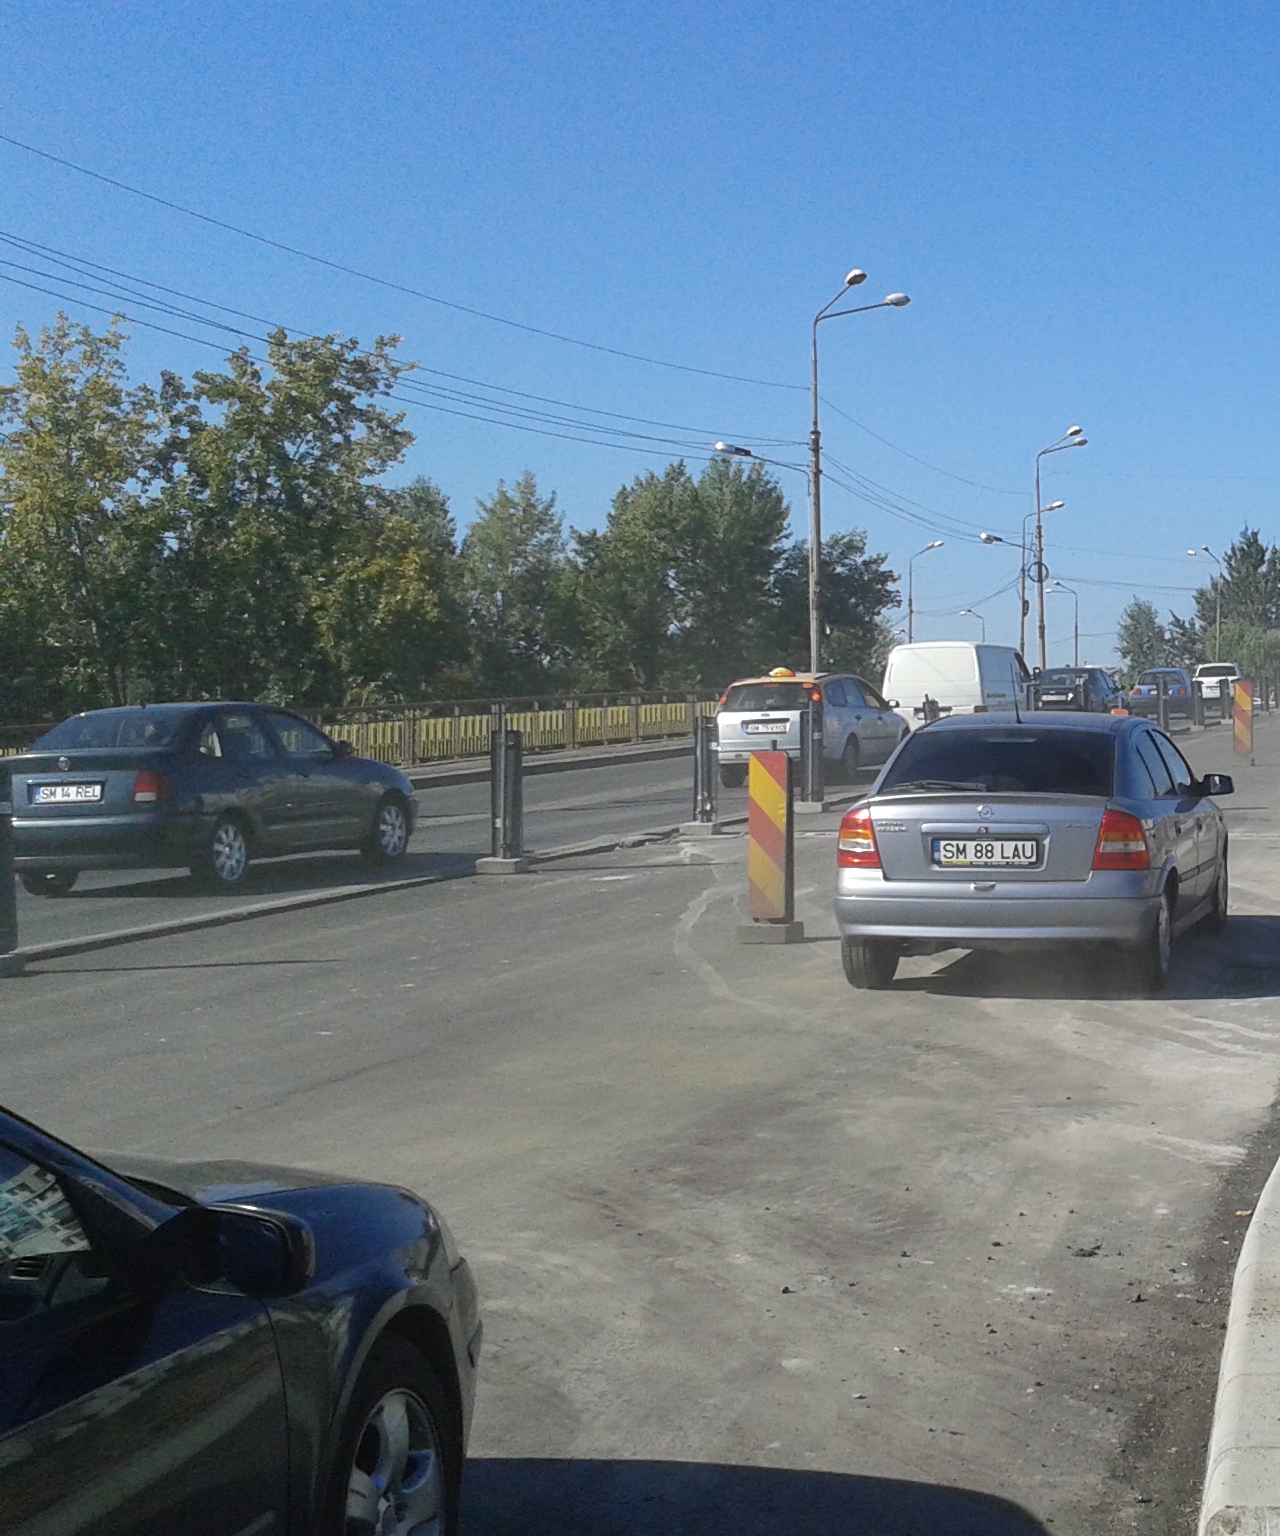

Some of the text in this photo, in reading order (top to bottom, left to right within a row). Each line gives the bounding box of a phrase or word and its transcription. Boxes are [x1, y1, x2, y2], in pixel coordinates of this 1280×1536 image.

[41, 785, 99, 799] SM 14 REL
[942, 843, 1035, 860] SM 88 LAU
